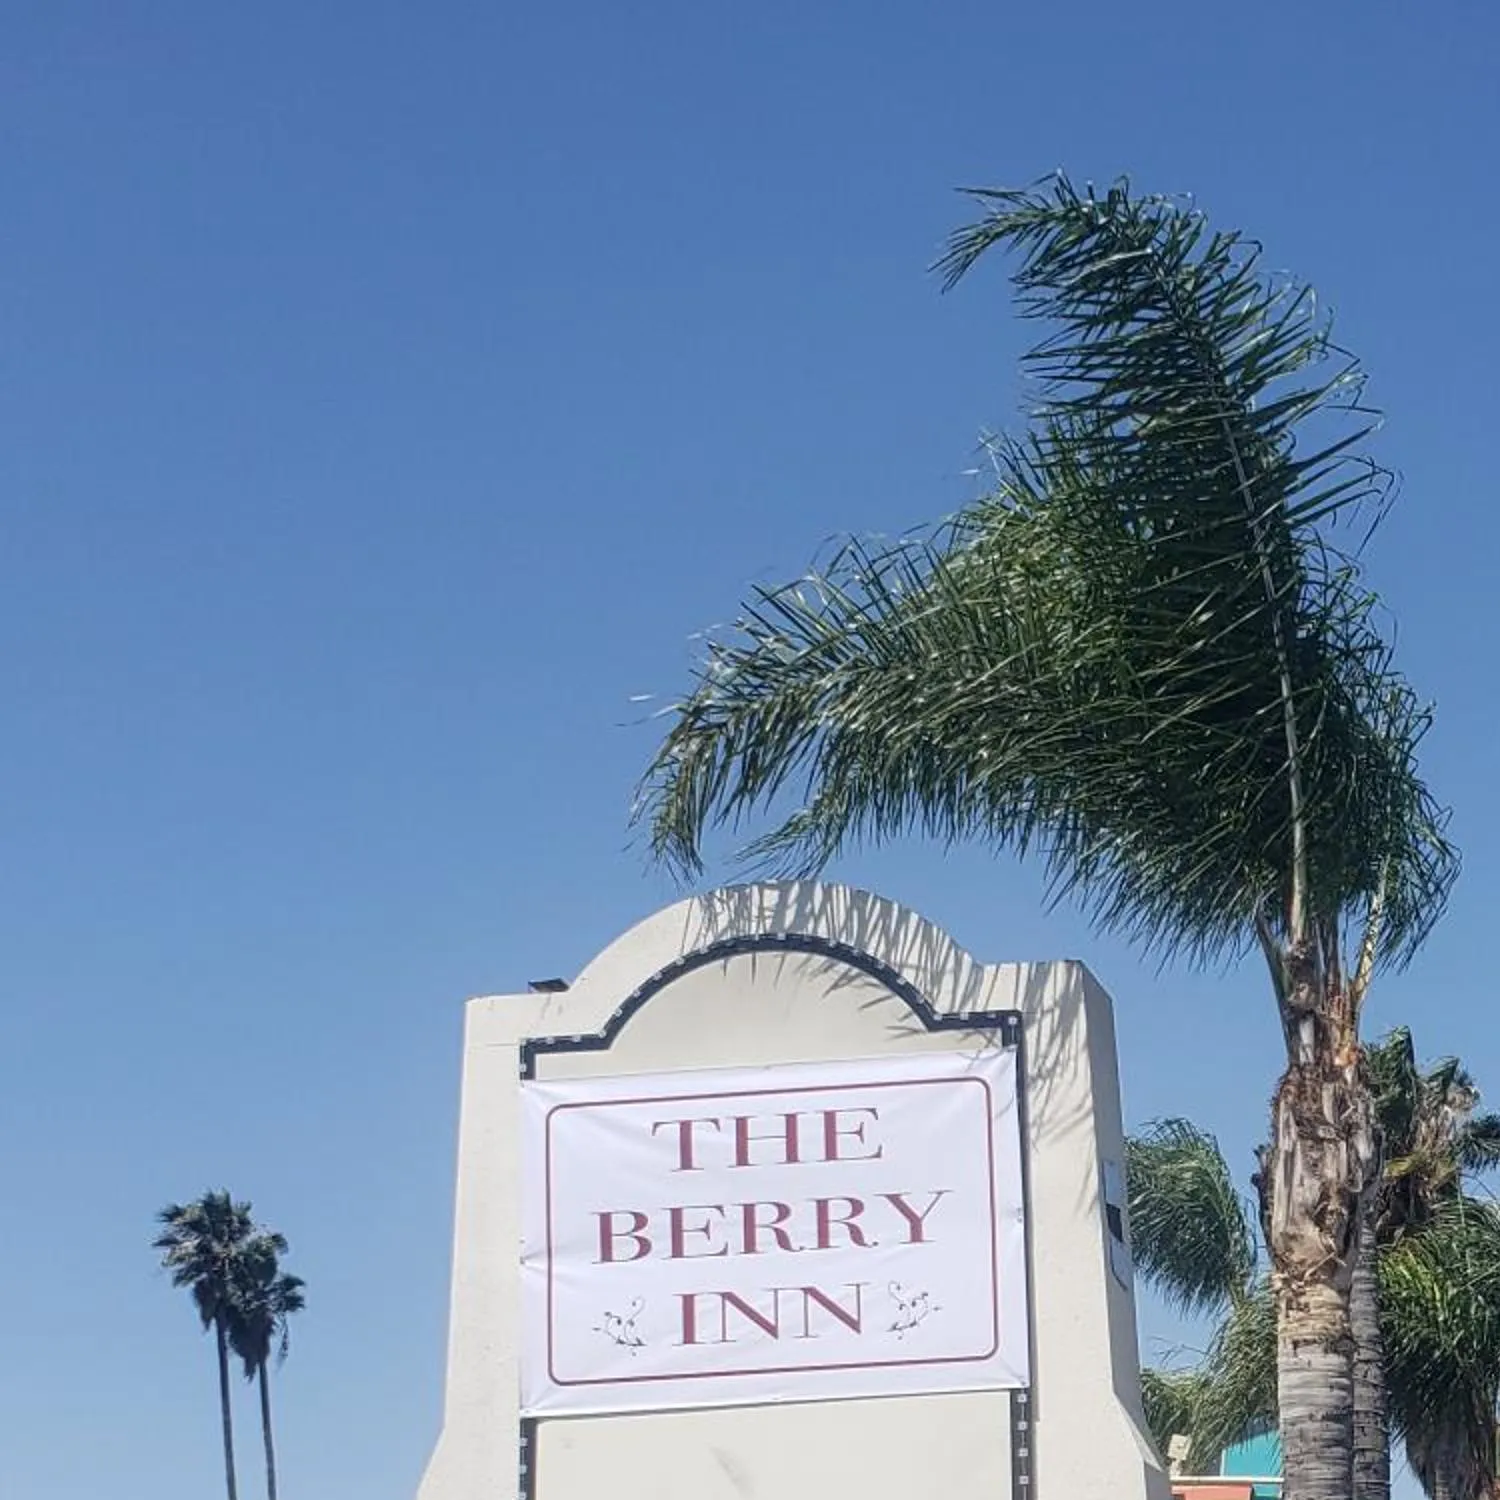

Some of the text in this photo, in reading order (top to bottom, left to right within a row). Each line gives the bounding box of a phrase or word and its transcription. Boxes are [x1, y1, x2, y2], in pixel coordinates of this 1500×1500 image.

[651, 1107, 883, 1173] THE
[591, 1189, 953, 1265] BERRY
[671, 1282, 871, 1348] INN
